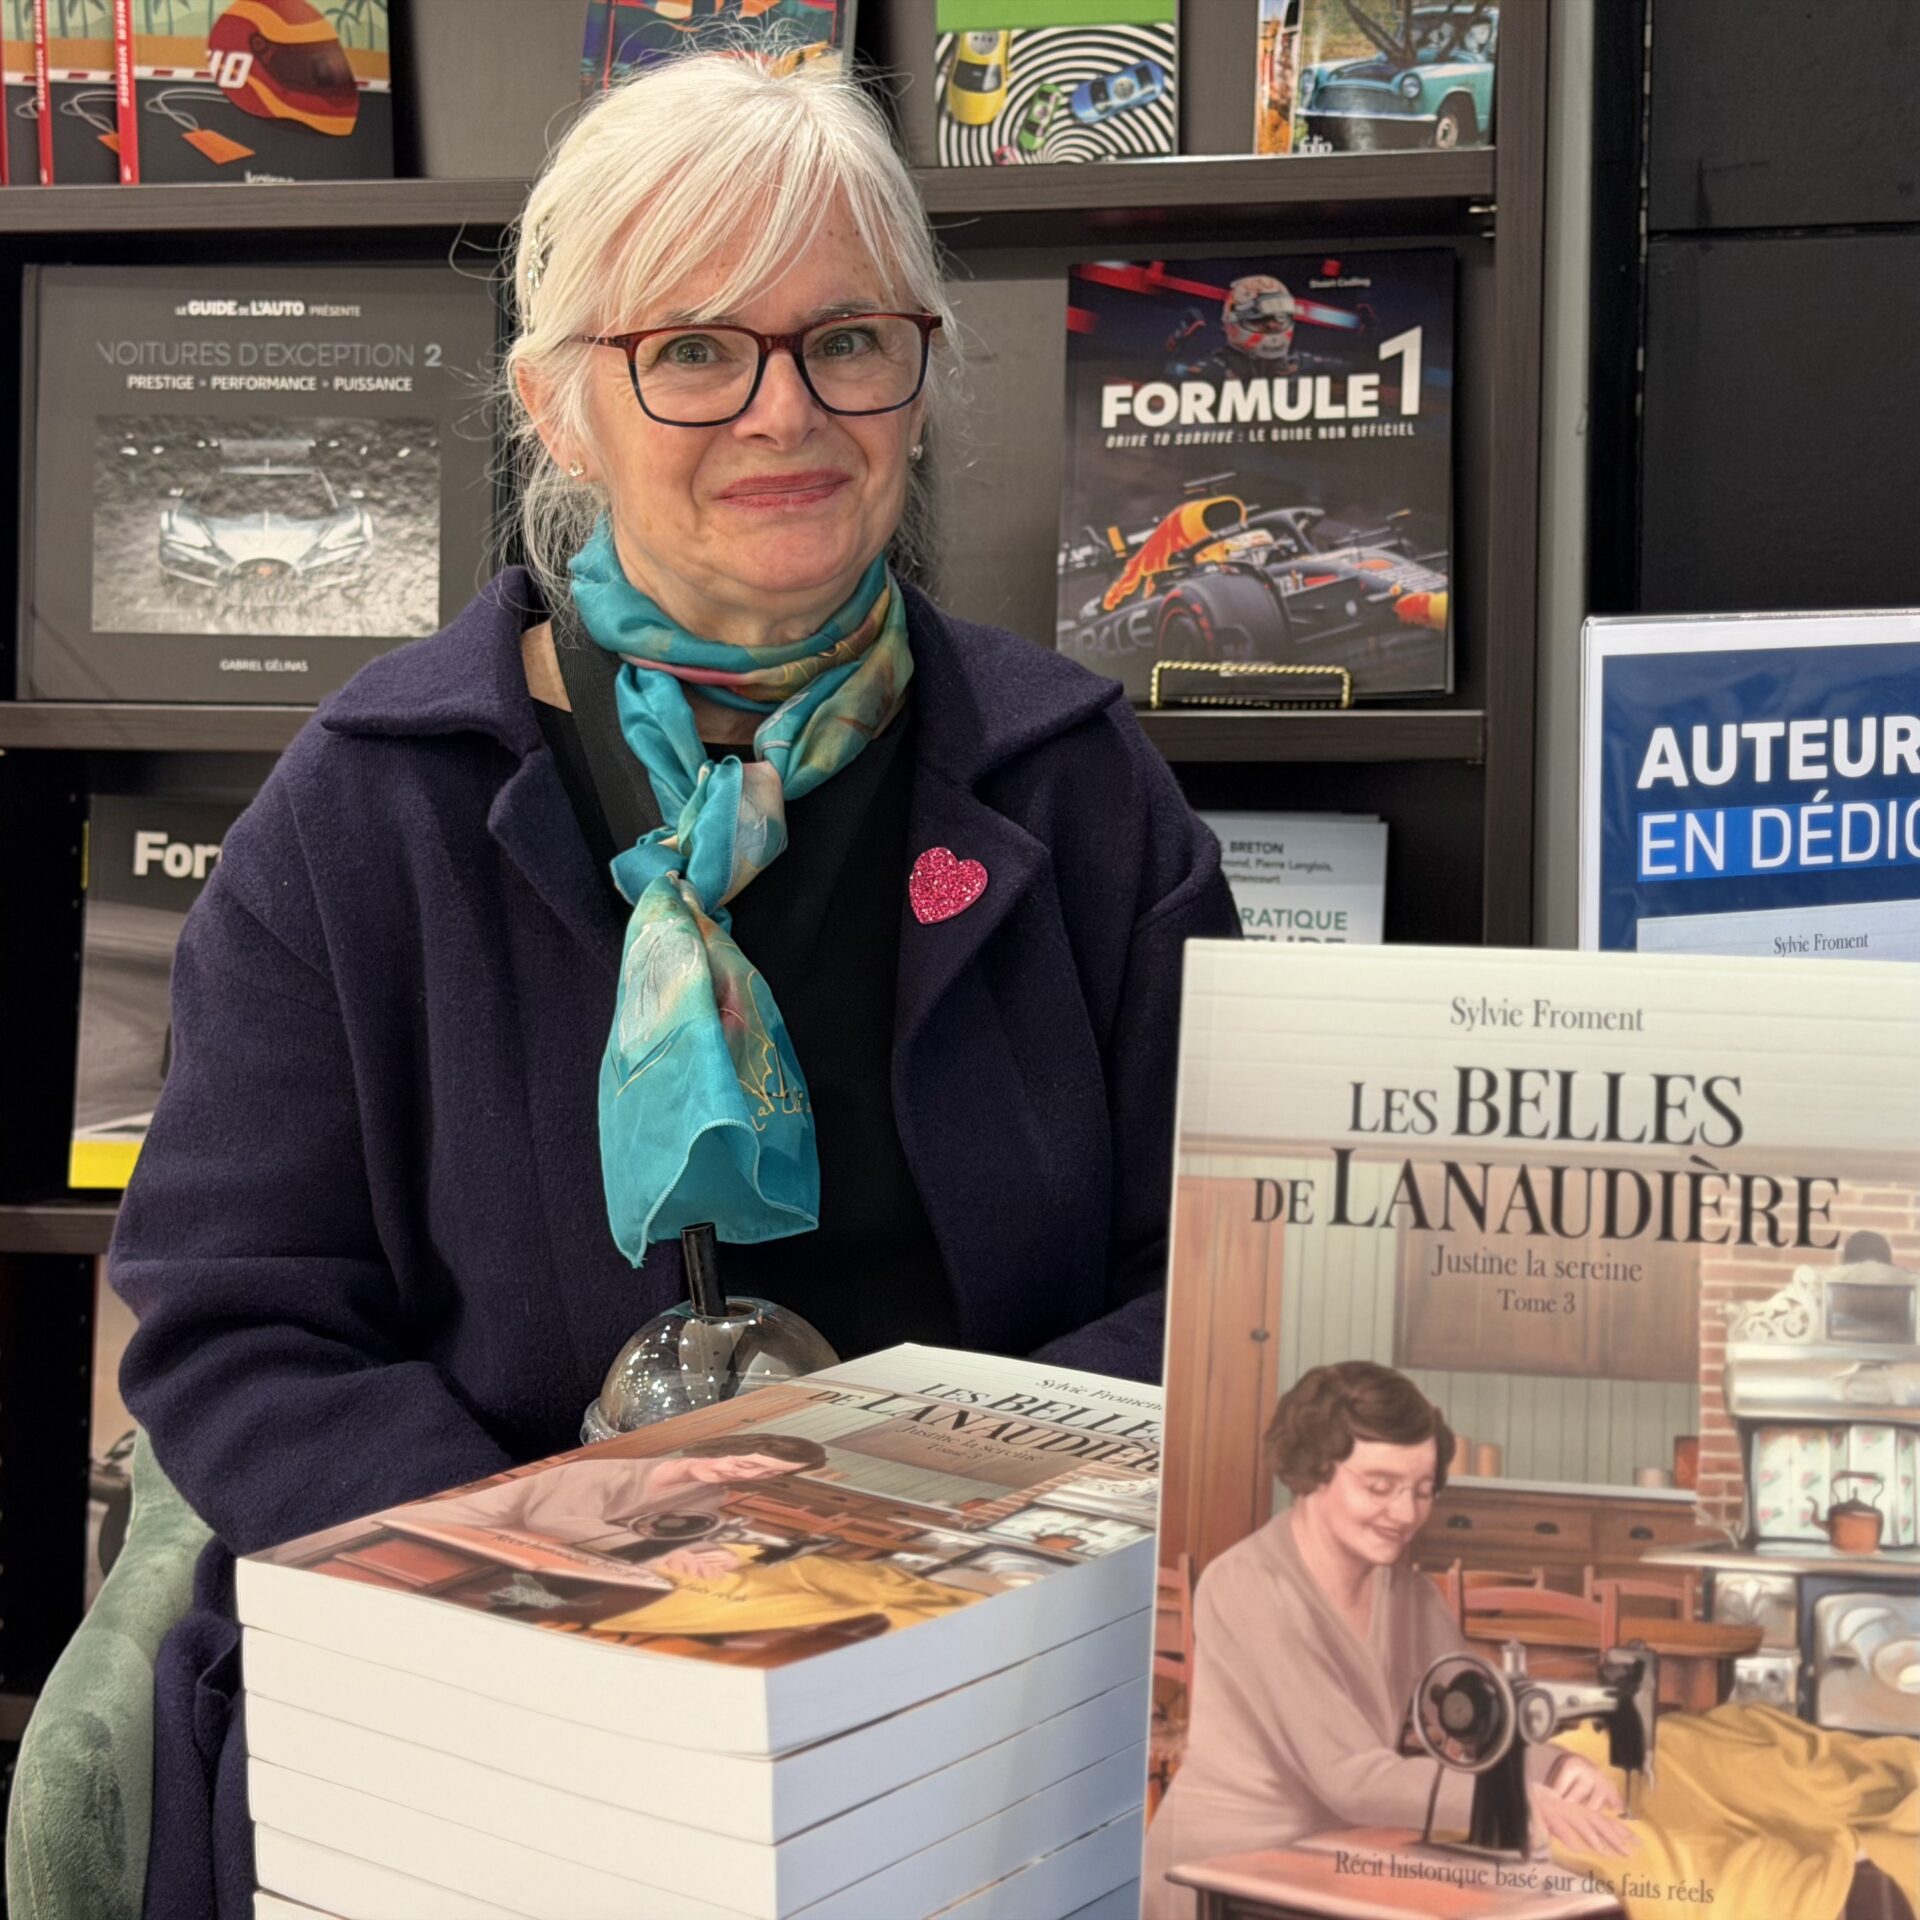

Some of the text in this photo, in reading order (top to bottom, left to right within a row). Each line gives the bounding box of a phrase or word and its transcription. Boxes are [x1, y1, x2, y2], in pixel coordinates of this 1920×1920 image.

[187, 301, 237, 316] GUIDE
[250, 300, 304, 316] L'AUTO
[309, 304, 361, 317] PRÉSENTE
[95, 341, 442, 367] VOITURES D'EXCEPTION 2
[127, 375, 413, 393] PRESTIGE PERFORMANCE PUISSANCE
[1102, 325, 1423, 428] FORMULE 1
[1106, 434, 1149, 448] DRIVE
[1154, 433, 1171, 446] TO
[1174, 430, 1235, 445] SURVIVE
[1249, 427, 1266, 442] LE
[1271, 426, 1314, 441] GUIDE
[1318, 425, 1347, 439] NON
[1351, 422, 1416, 438] OFFICIEL
[219, 658, 262, 671] GABRIEL
[1230, 841, 1284, 854] BRETON
[1641, 811, 1725, 876] EN
[1241, 908, 1348, 930] RATIQUE
[1773, 933, 1869, 957] Sylvie Froment
[1450, 996, 1645, 1032] Sylvie Froment
[1348, 1065, 1744, 1148] LES BELLES
[1251, 1146, 1841, 1250] DE LANAUDIÈRE
[1430, 1244, 1643, 1282] Justine la sereine
[1497, 1288, 1576, 1314] Tome 3
[806, 1390, 865, 1406] DE
[1036, 1379, 1088, 1395] Sylvie
[915, 1383, 1162, 1444] LES BELLE
[896, 1425, 961, 1443] Justine
[1334, 1851, 1715, 1904] Récit historique basé sur des faits réels
